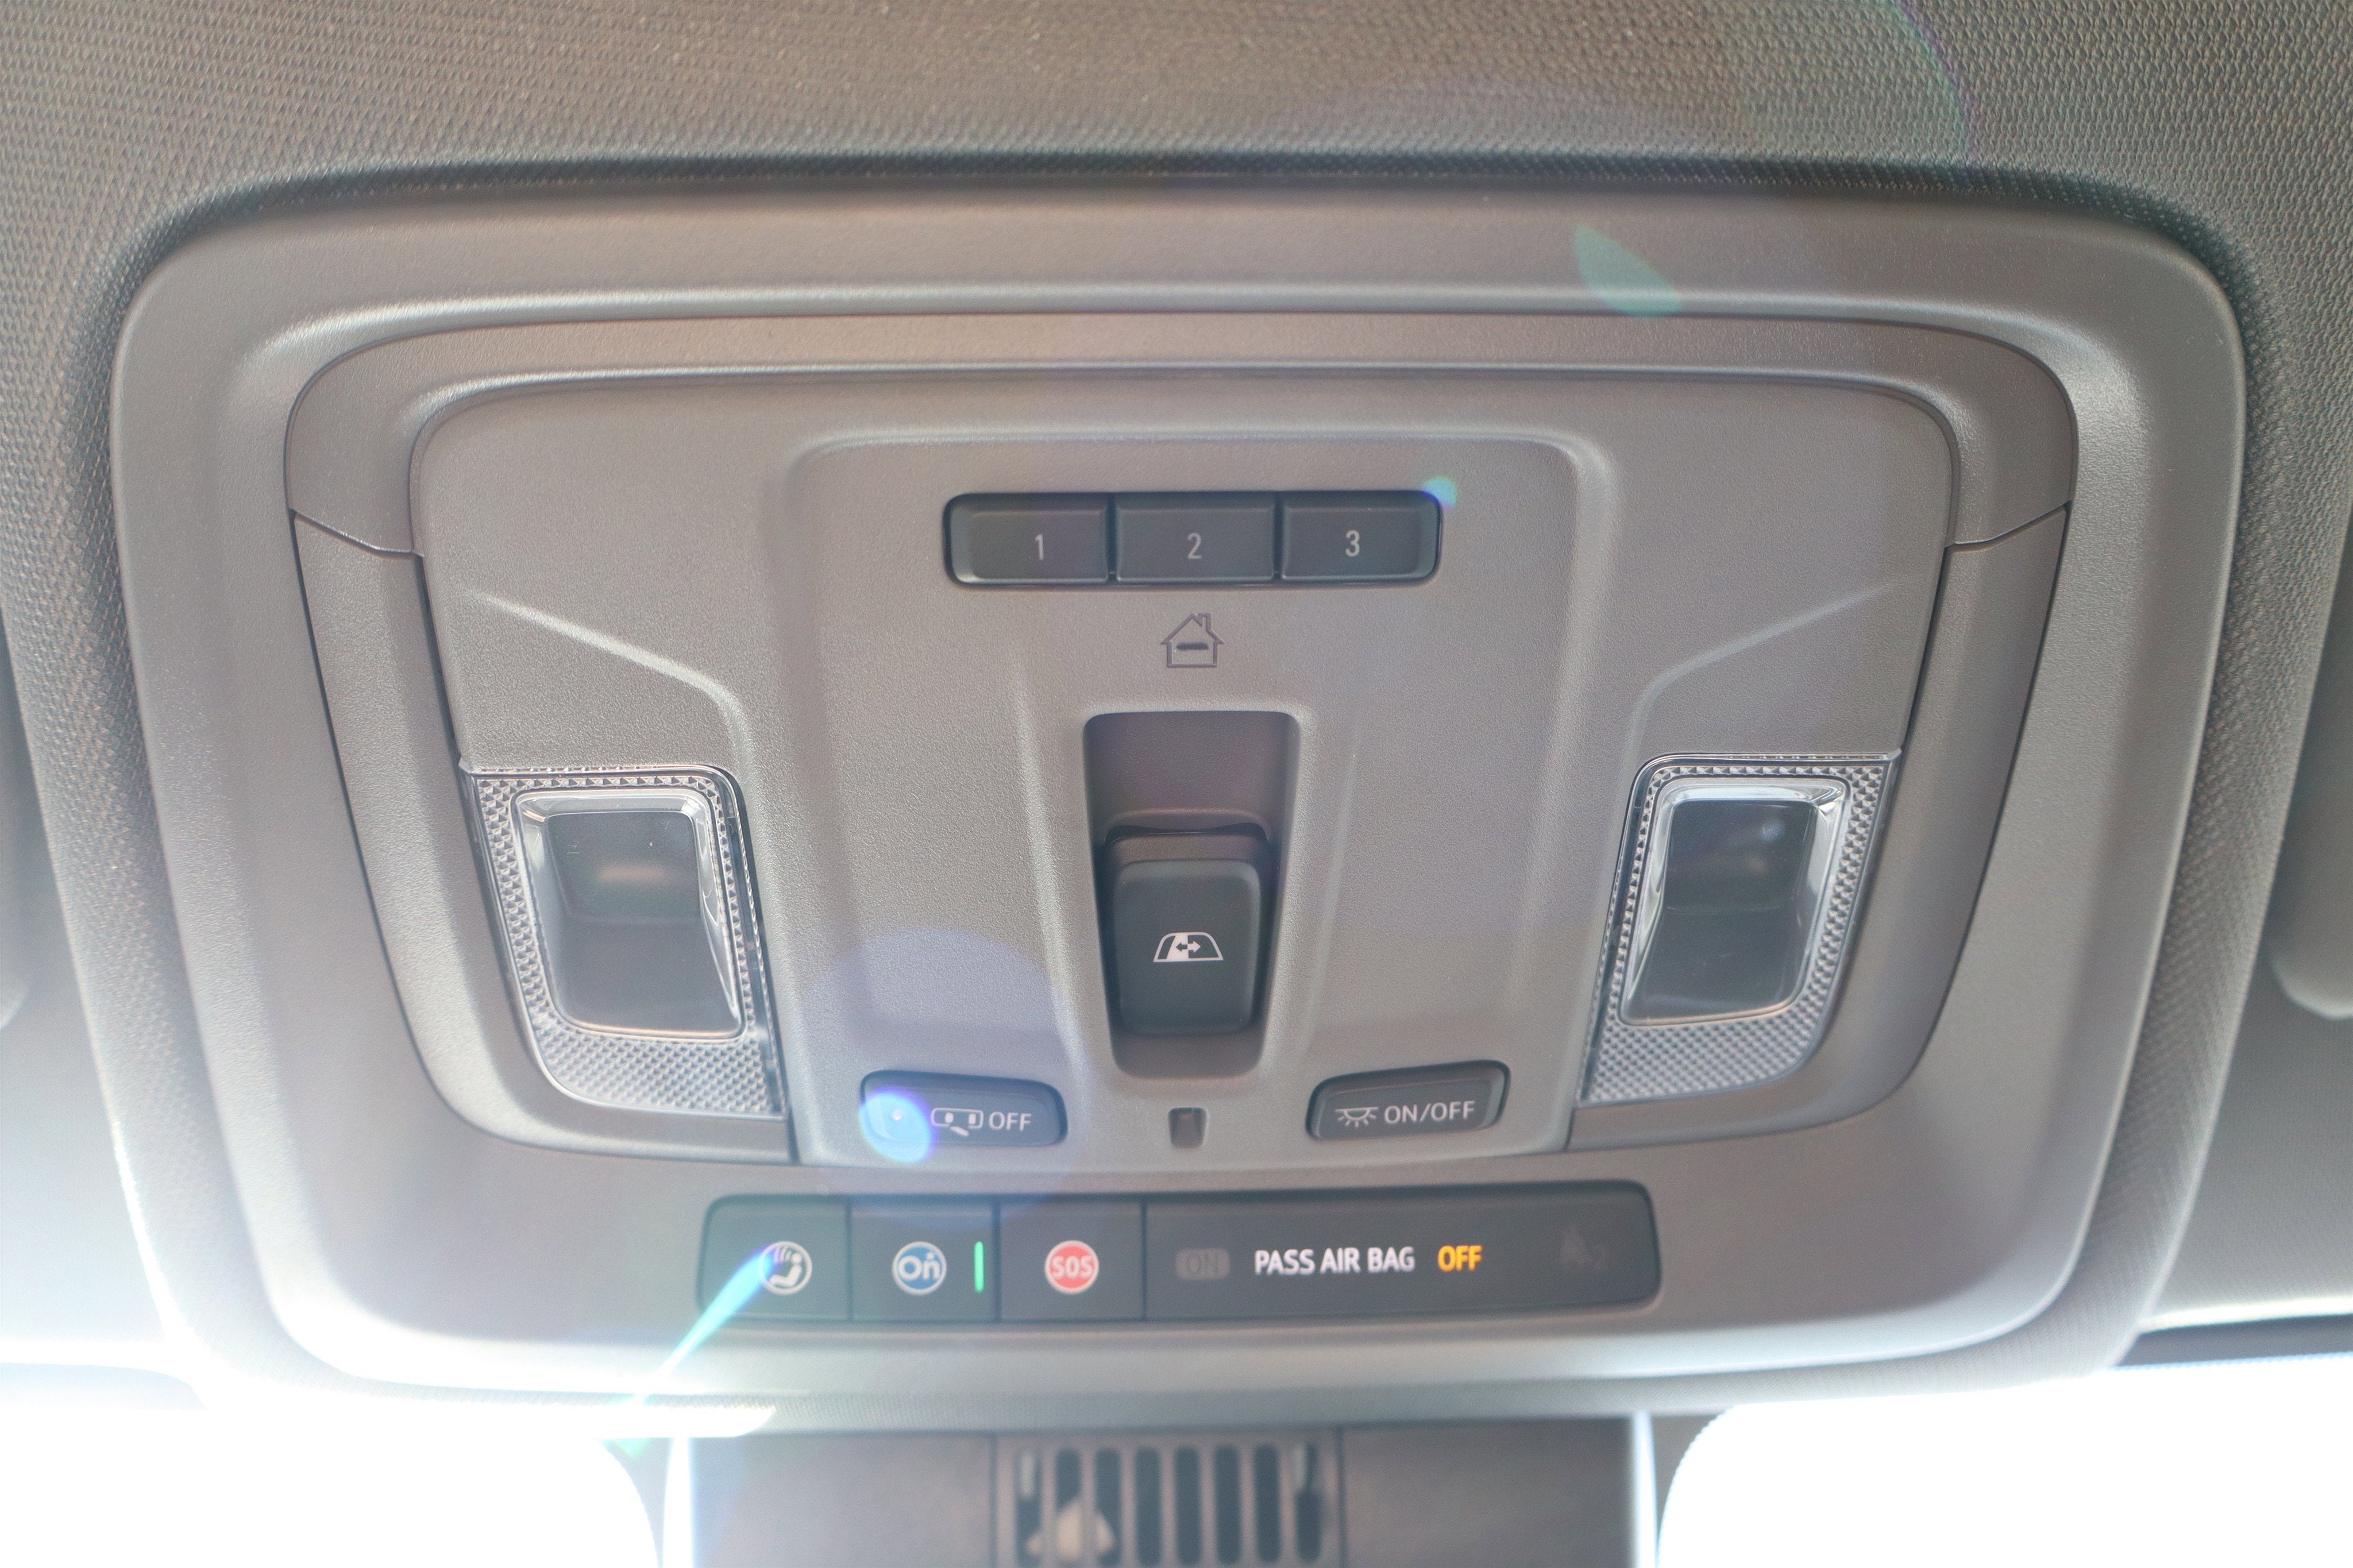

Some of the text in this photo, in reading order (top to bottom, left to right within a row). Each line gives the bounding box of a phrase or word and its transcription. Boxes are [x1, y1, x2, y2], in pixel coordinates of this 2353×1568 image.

[1036, 534, 1044, 561] 1
[1187, 533, 1203, 560] 2
[1345, 530, 1360, 557] 3
[989, 1111, 1032, 1130] OFF
[1384, 1100, 1476, 1124] ON/OFF
[1052, 1256, 1093, 1278] SOS
[1255, 1245, 1482, 1275] PASS AIR BAG OFF
